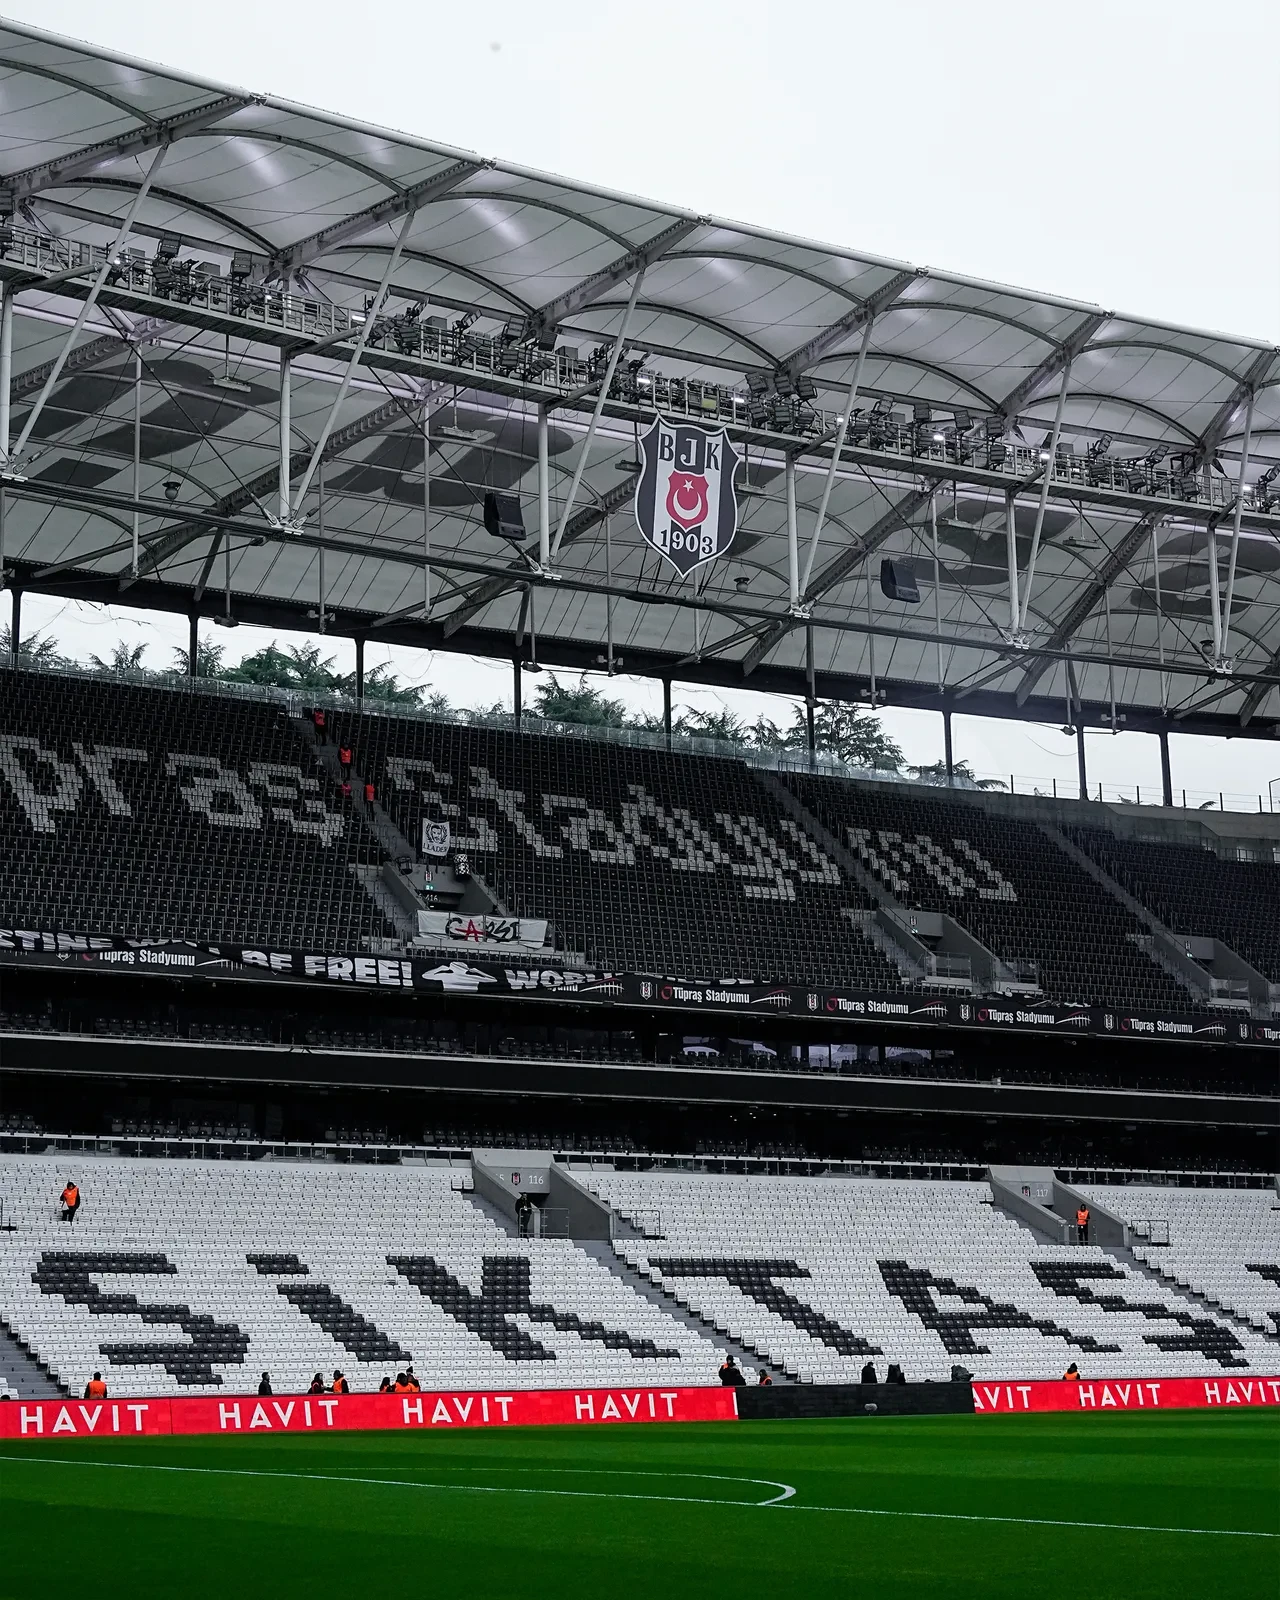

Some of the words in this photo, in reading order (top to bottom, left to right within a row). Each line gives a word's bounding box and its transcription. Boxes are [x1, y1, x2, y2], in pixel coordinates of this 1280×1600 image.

[658, 433, 720, 471] BJK
[659, 529, 713, 555] 1903
[139, 949, 195, 966] Stadyumu
[304, 955, 413, 987] FREE!
[672, 986, 703, 1004] Tüpraş
[705, 990, 750, 1008] Stadyumu
[837, 997, 865, 1014] Tüpraş
[867, 1000, 909, 1016] Stadyumu
[987, 1007, 1014, 1024] Tüpraş
[1016, 1010, 1055, 1026] Stadyumu
[1130, 1018, 1155, 1033] Tüpraş
[1157, 1020, 1193, 1035] Stadyumu
[529, 1175, 544, 1185] 116
[1036, 1189, 1049, 1198] 117
[1078, 1383, 1161, 1408] HAVIT
[1203, 1381, 1280, 1404] HAVIT
[218, 1399, 339, 1430] HAVIT
[402, 1396, 514, 1424] HAVIT
[574, 1392, 678, 1420] HAVIT
[20, 1403, 149, 1435] HAVIT
